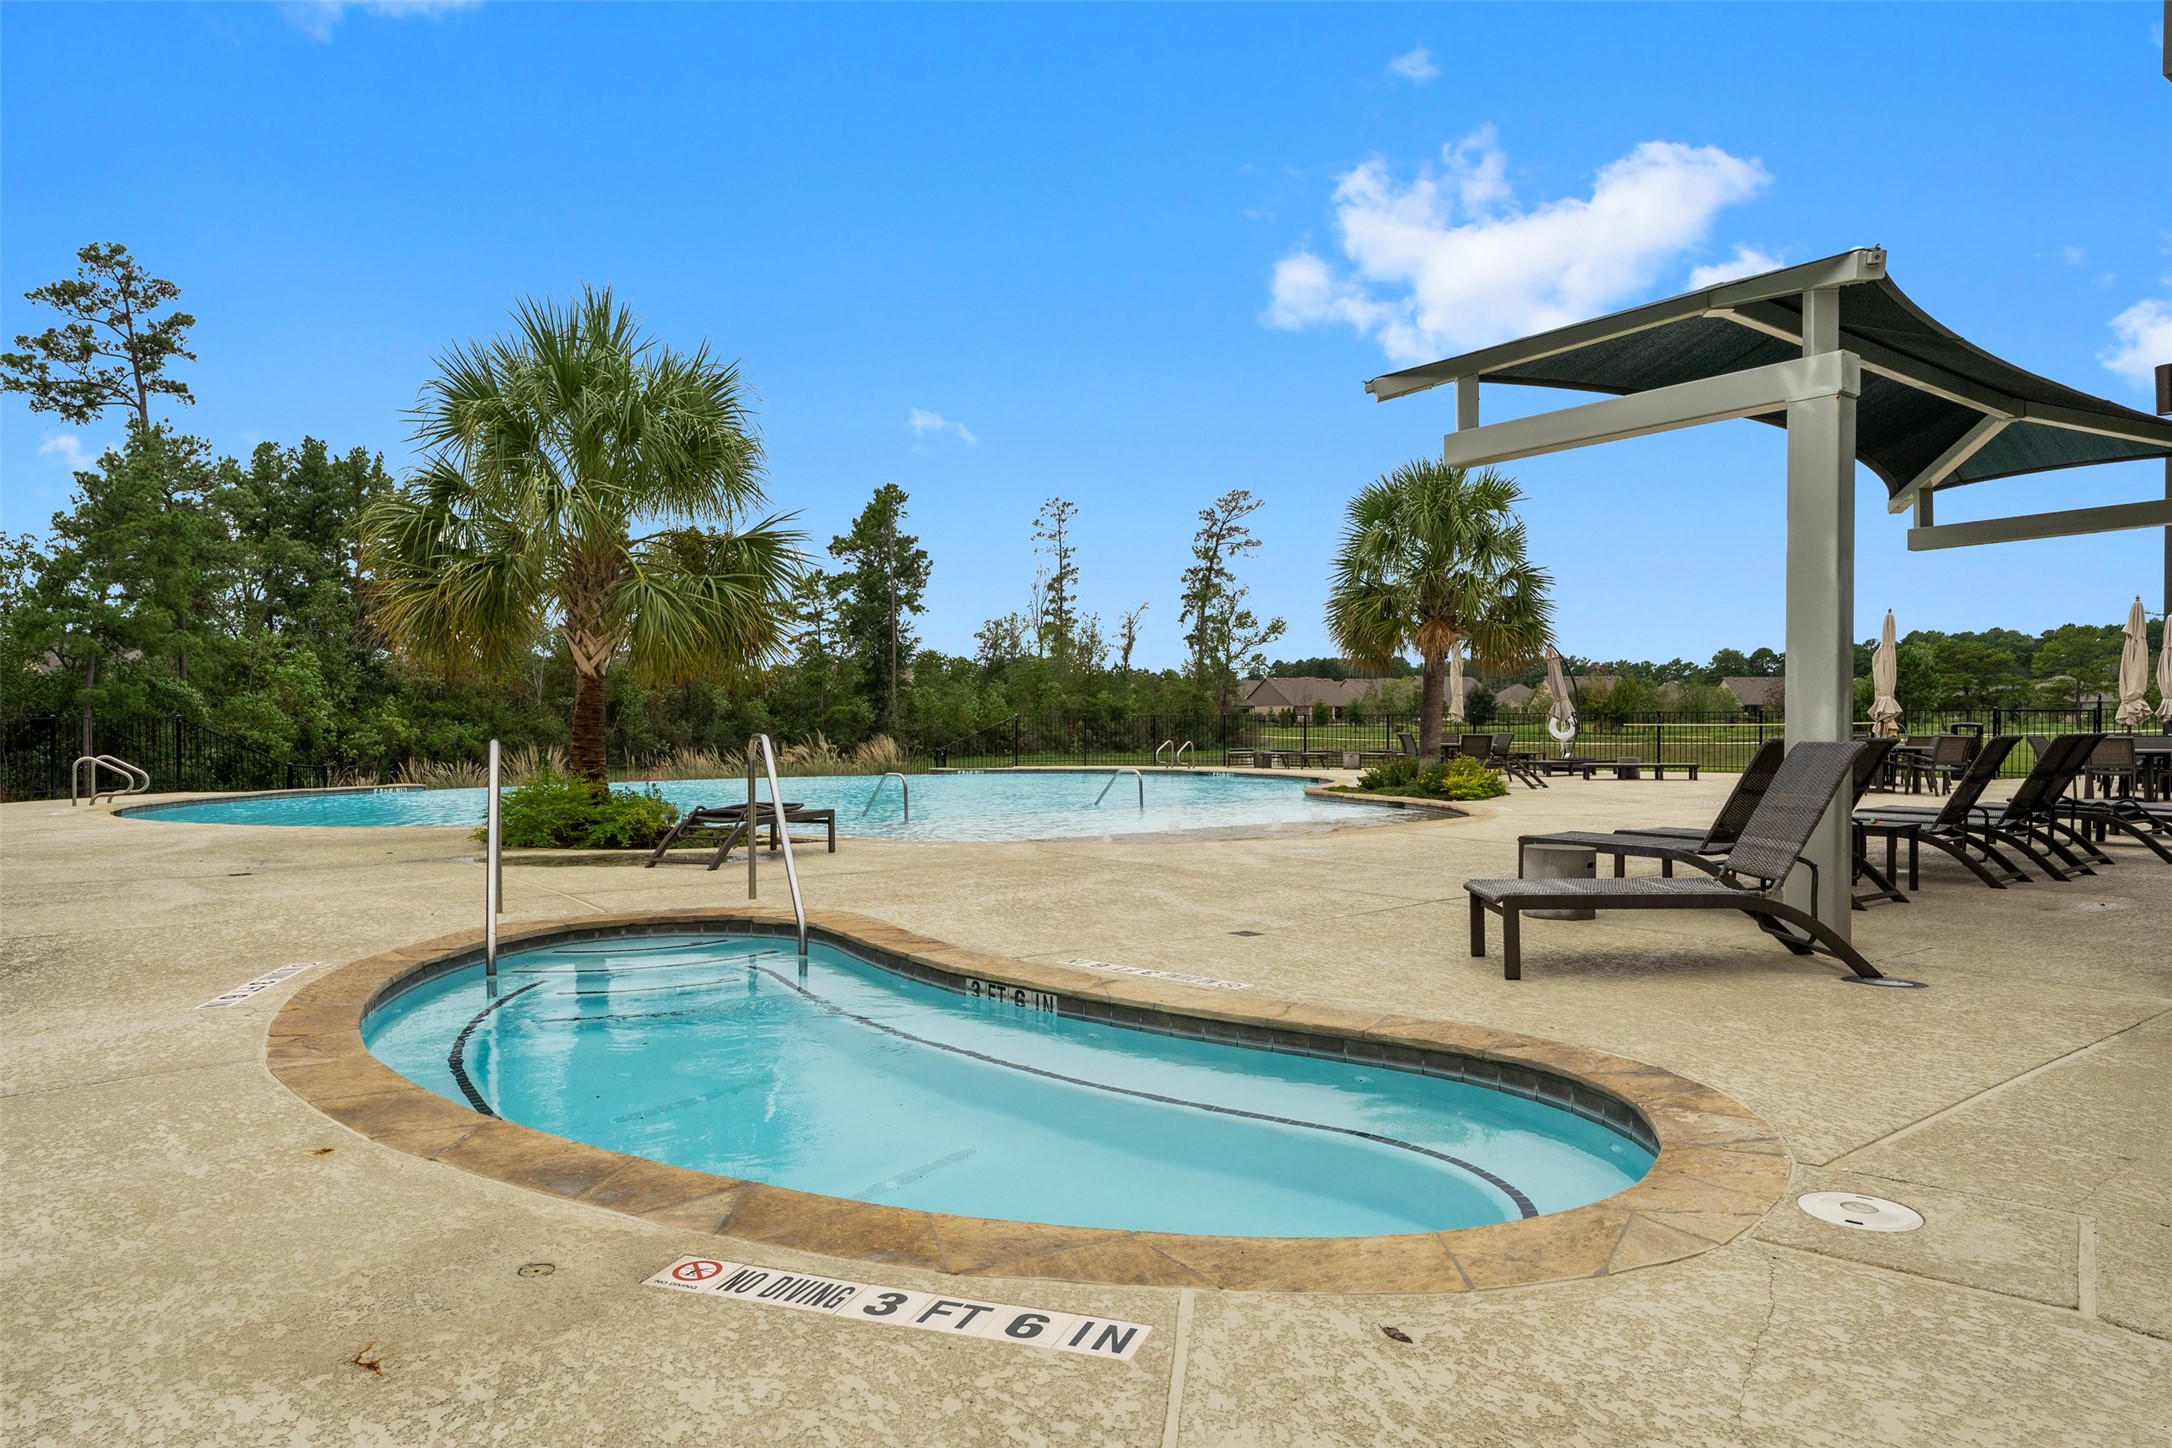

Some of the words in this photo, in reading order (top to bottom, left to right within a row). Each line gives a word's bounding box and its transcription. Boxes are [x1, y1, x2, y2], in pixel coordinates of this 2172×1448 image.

[971, 980, 981, 997] 3
[988, 983, 1006, 1003] FT
[1014, 989, 1026, 1008] 6
[1035, 993, 1054, 1014] IN
[668, 1281, 698, 1290] DIVING
[715, 1269, 770, 1294] NO
[756, 1275, 856, 1309] DIVING
[862, 1292, 909, 1316] 3
[916, 1300, 995, 1330] FT
[1004, 1313, 1051, 1339] 6
[1068, 1321, 1138, 1354] IN
